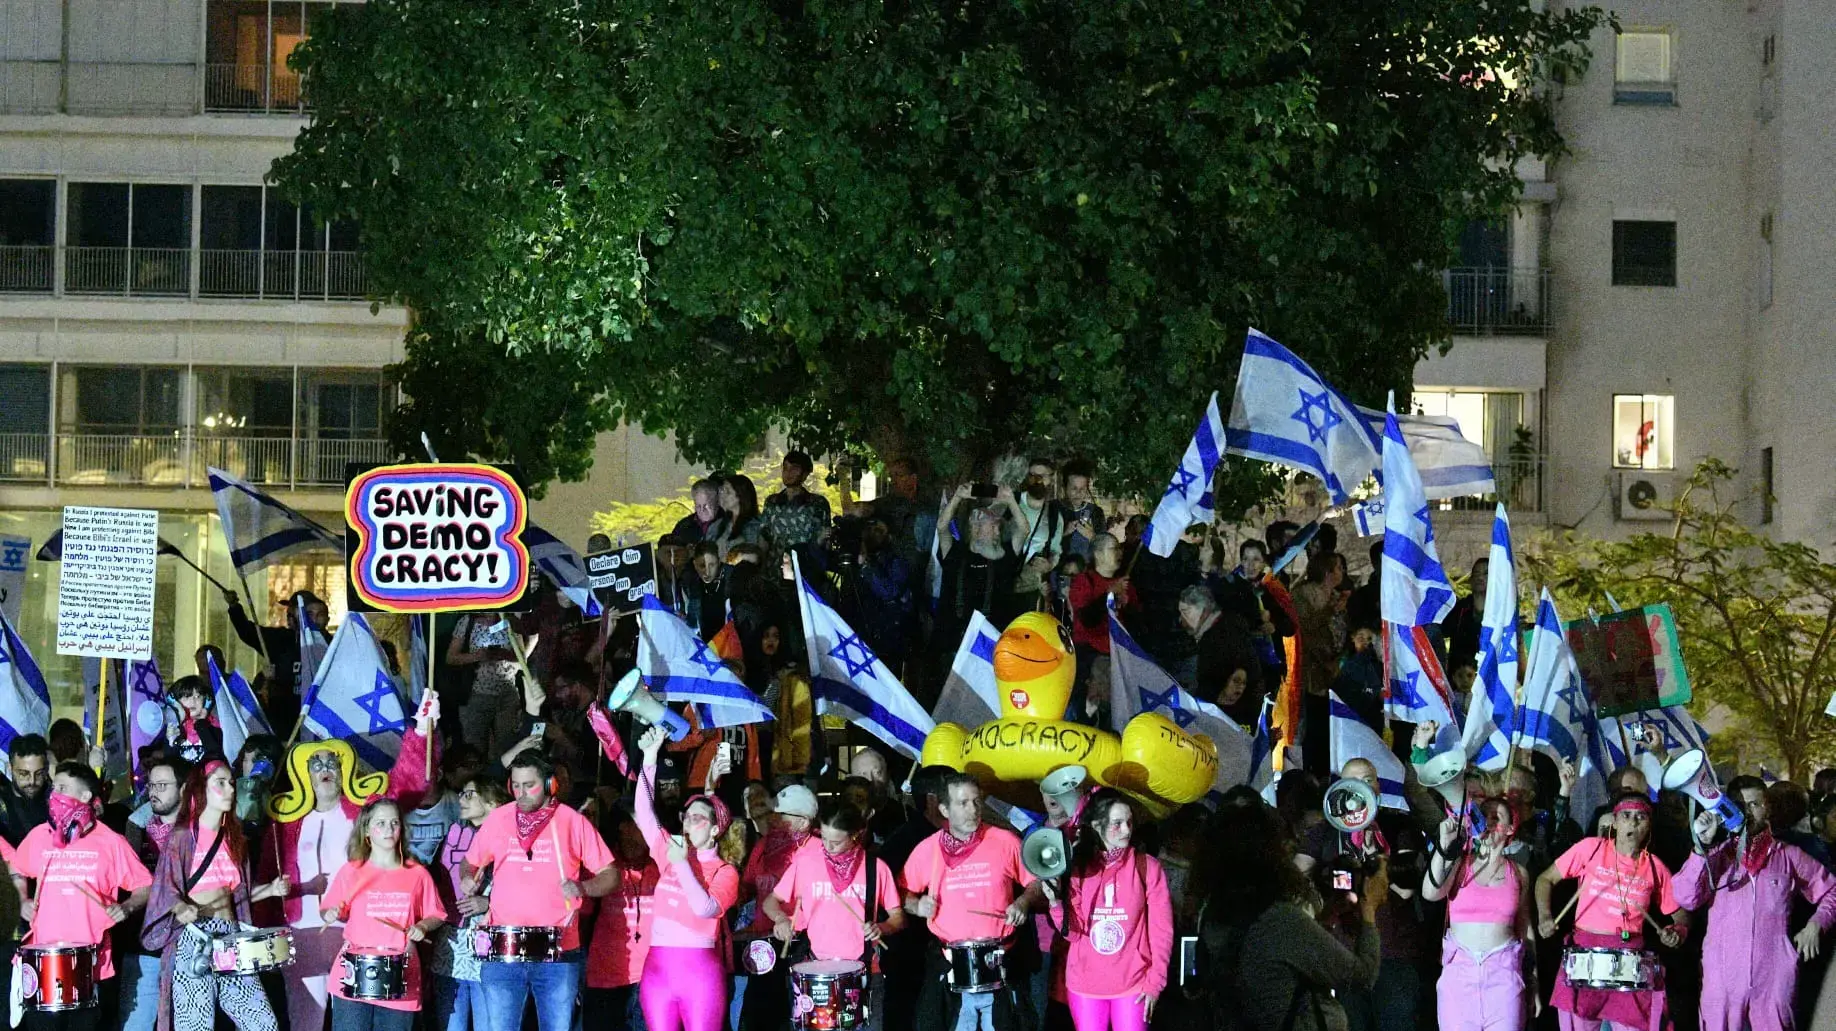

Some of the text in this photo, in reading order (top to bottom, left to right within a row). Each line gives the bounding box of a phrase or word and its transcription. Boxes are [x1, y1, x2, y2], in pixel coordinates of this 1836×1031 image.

[64, 532, 91, 540] Because
[65, 543, 83, 551] פוטין
[64, 552, 88, 560] מלחמה
[591, 551, 639, 569] Declare him
[375, 553, 499, 583] CRACY!
[122, 574, 144, 582] ישראל
[590, 575, 615, 587] ersona
